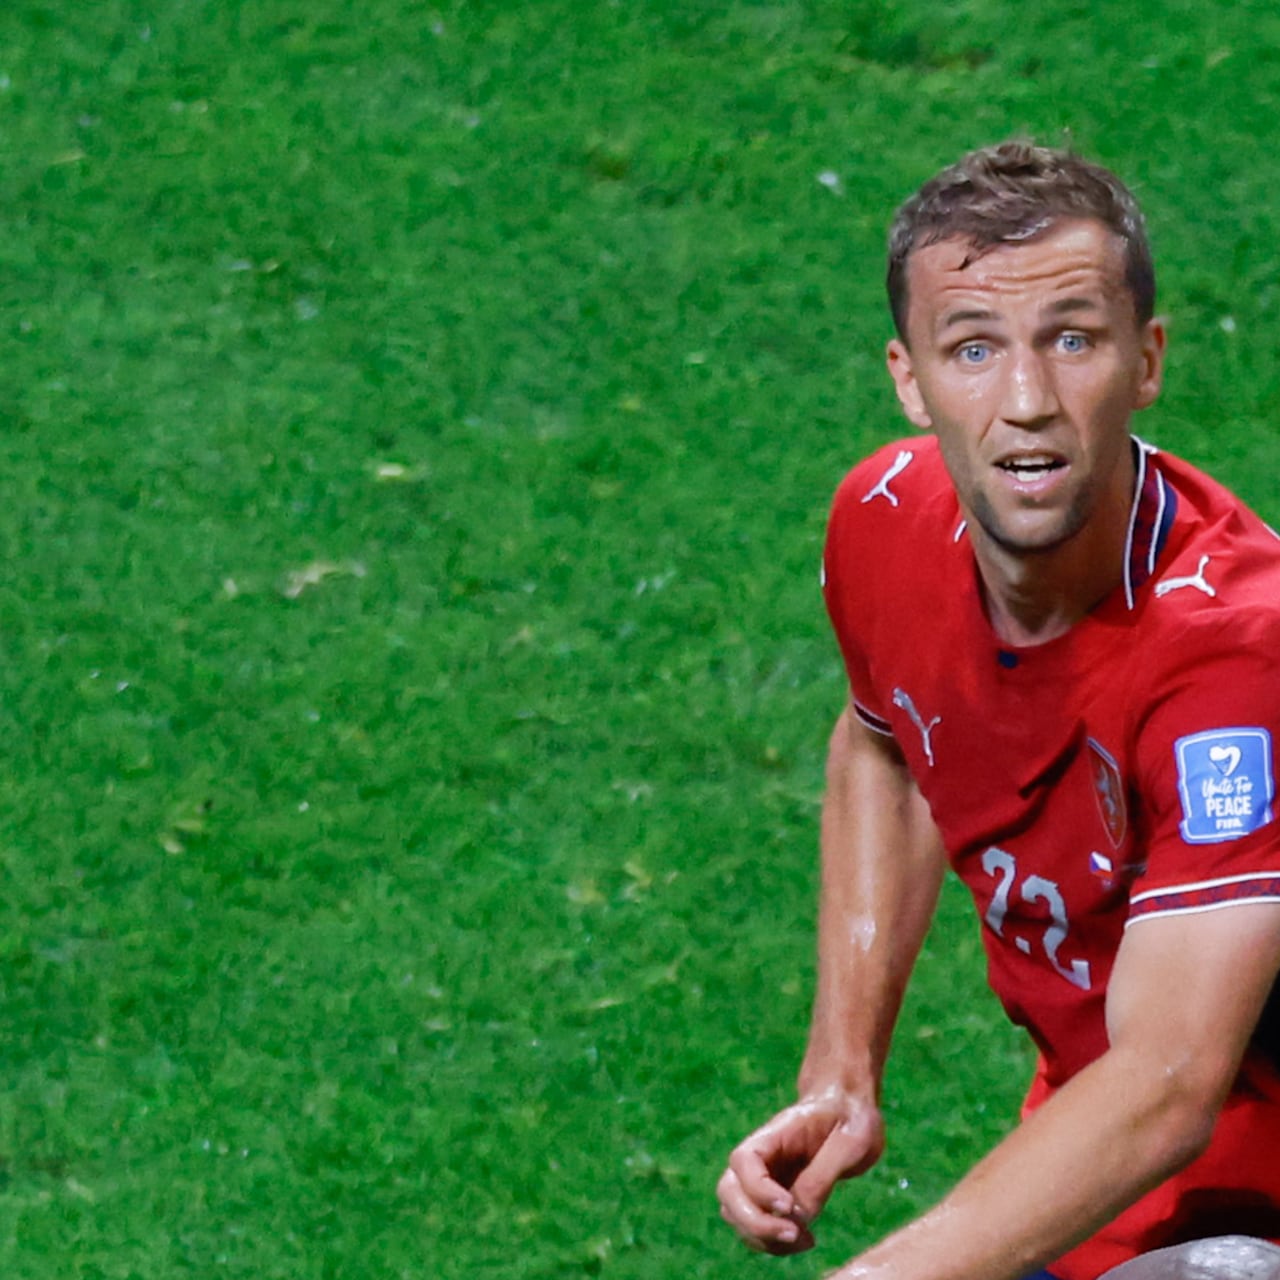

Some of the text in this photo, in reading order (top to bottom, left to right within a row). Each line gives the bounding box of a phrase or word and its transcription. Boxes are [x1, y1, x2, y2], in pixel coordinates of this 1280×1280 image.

[1202, 775, 1253, 799] Unite For
[1206, 795, 1253, 818] PEACE
[981, 846, 1091, 991] 22
